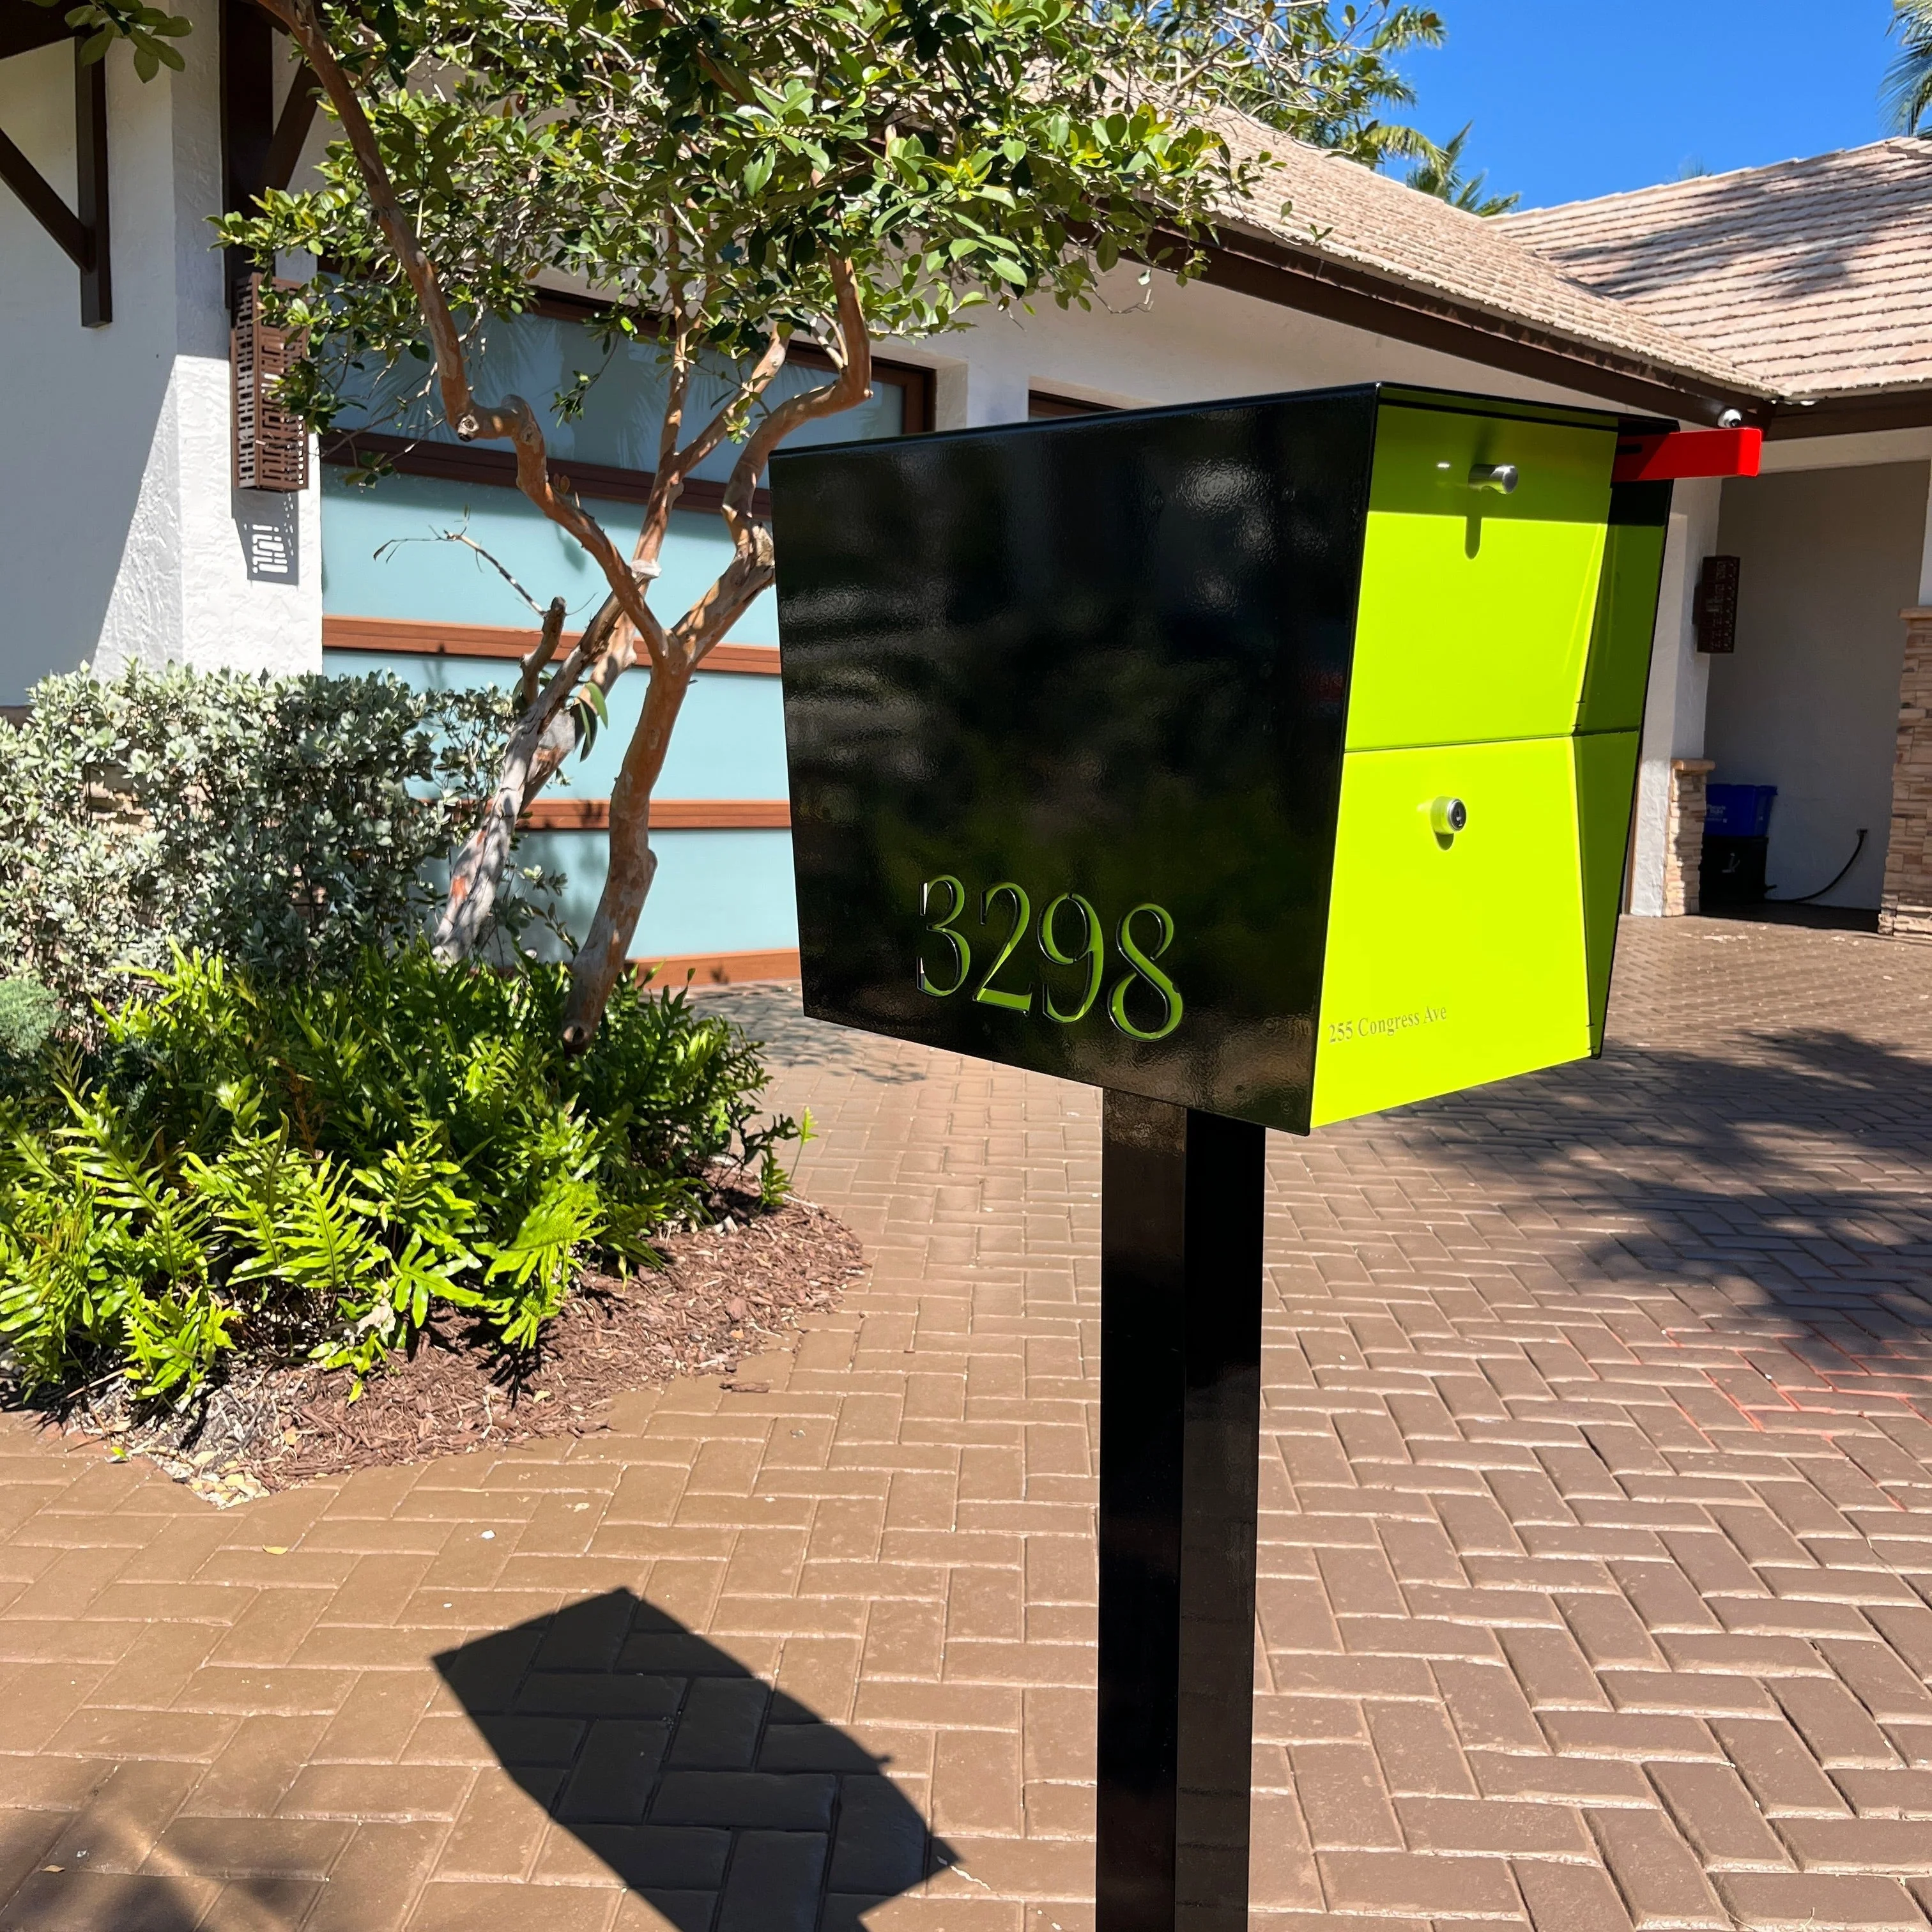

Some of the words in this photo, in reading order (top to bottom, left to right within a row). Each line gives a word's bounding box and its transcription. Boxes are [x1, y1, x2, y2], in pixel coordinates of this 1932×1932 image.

[917, 875, 1183, 1041] 3298
[1329, 1020, 1353, 1043] 255
[1358, 1012, 1420, 1036] Congress
[1423, 1006, 1447, 1024] Ave
